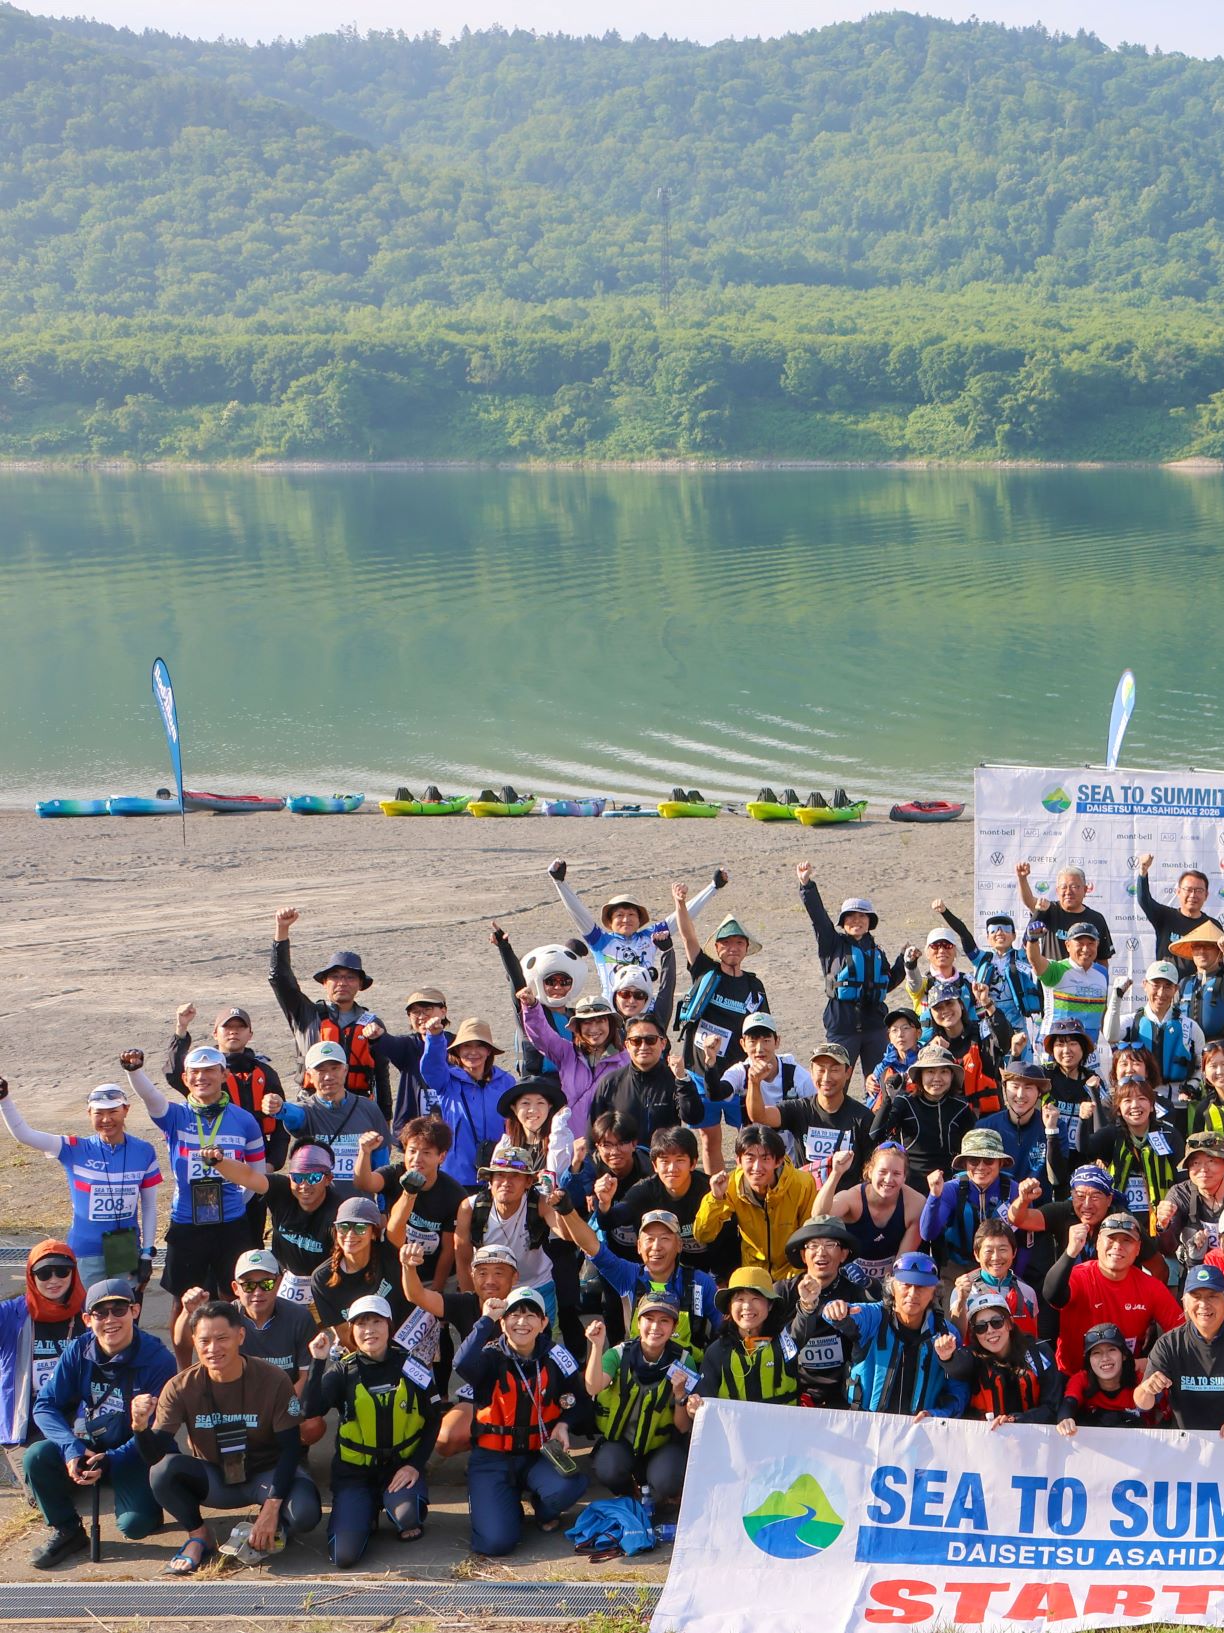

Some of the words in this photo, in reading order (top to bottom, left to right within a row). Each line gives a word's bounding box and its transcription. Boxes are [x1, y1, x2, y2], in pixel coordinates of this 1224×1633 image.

[1077, 784, 1114, 803] SEA
[1121, 786, 1144, 804] TO
[1086, 804, 1131, 813] DAISETSU
[804, 1348, 834, 1360] 010
[1180, 1376, 1196, 1386] SEA
[1197, 1376, 1208, 1386] TO
[195, 1414, 211, 1423] SEA
[222, 1414, 258, 1422] SUMMIT
[868, 1465, 994, 1530] SEA
[1011, 1475, 1092, 1536] TO
[947, 1540, 1096, 1568] DAISETSU
